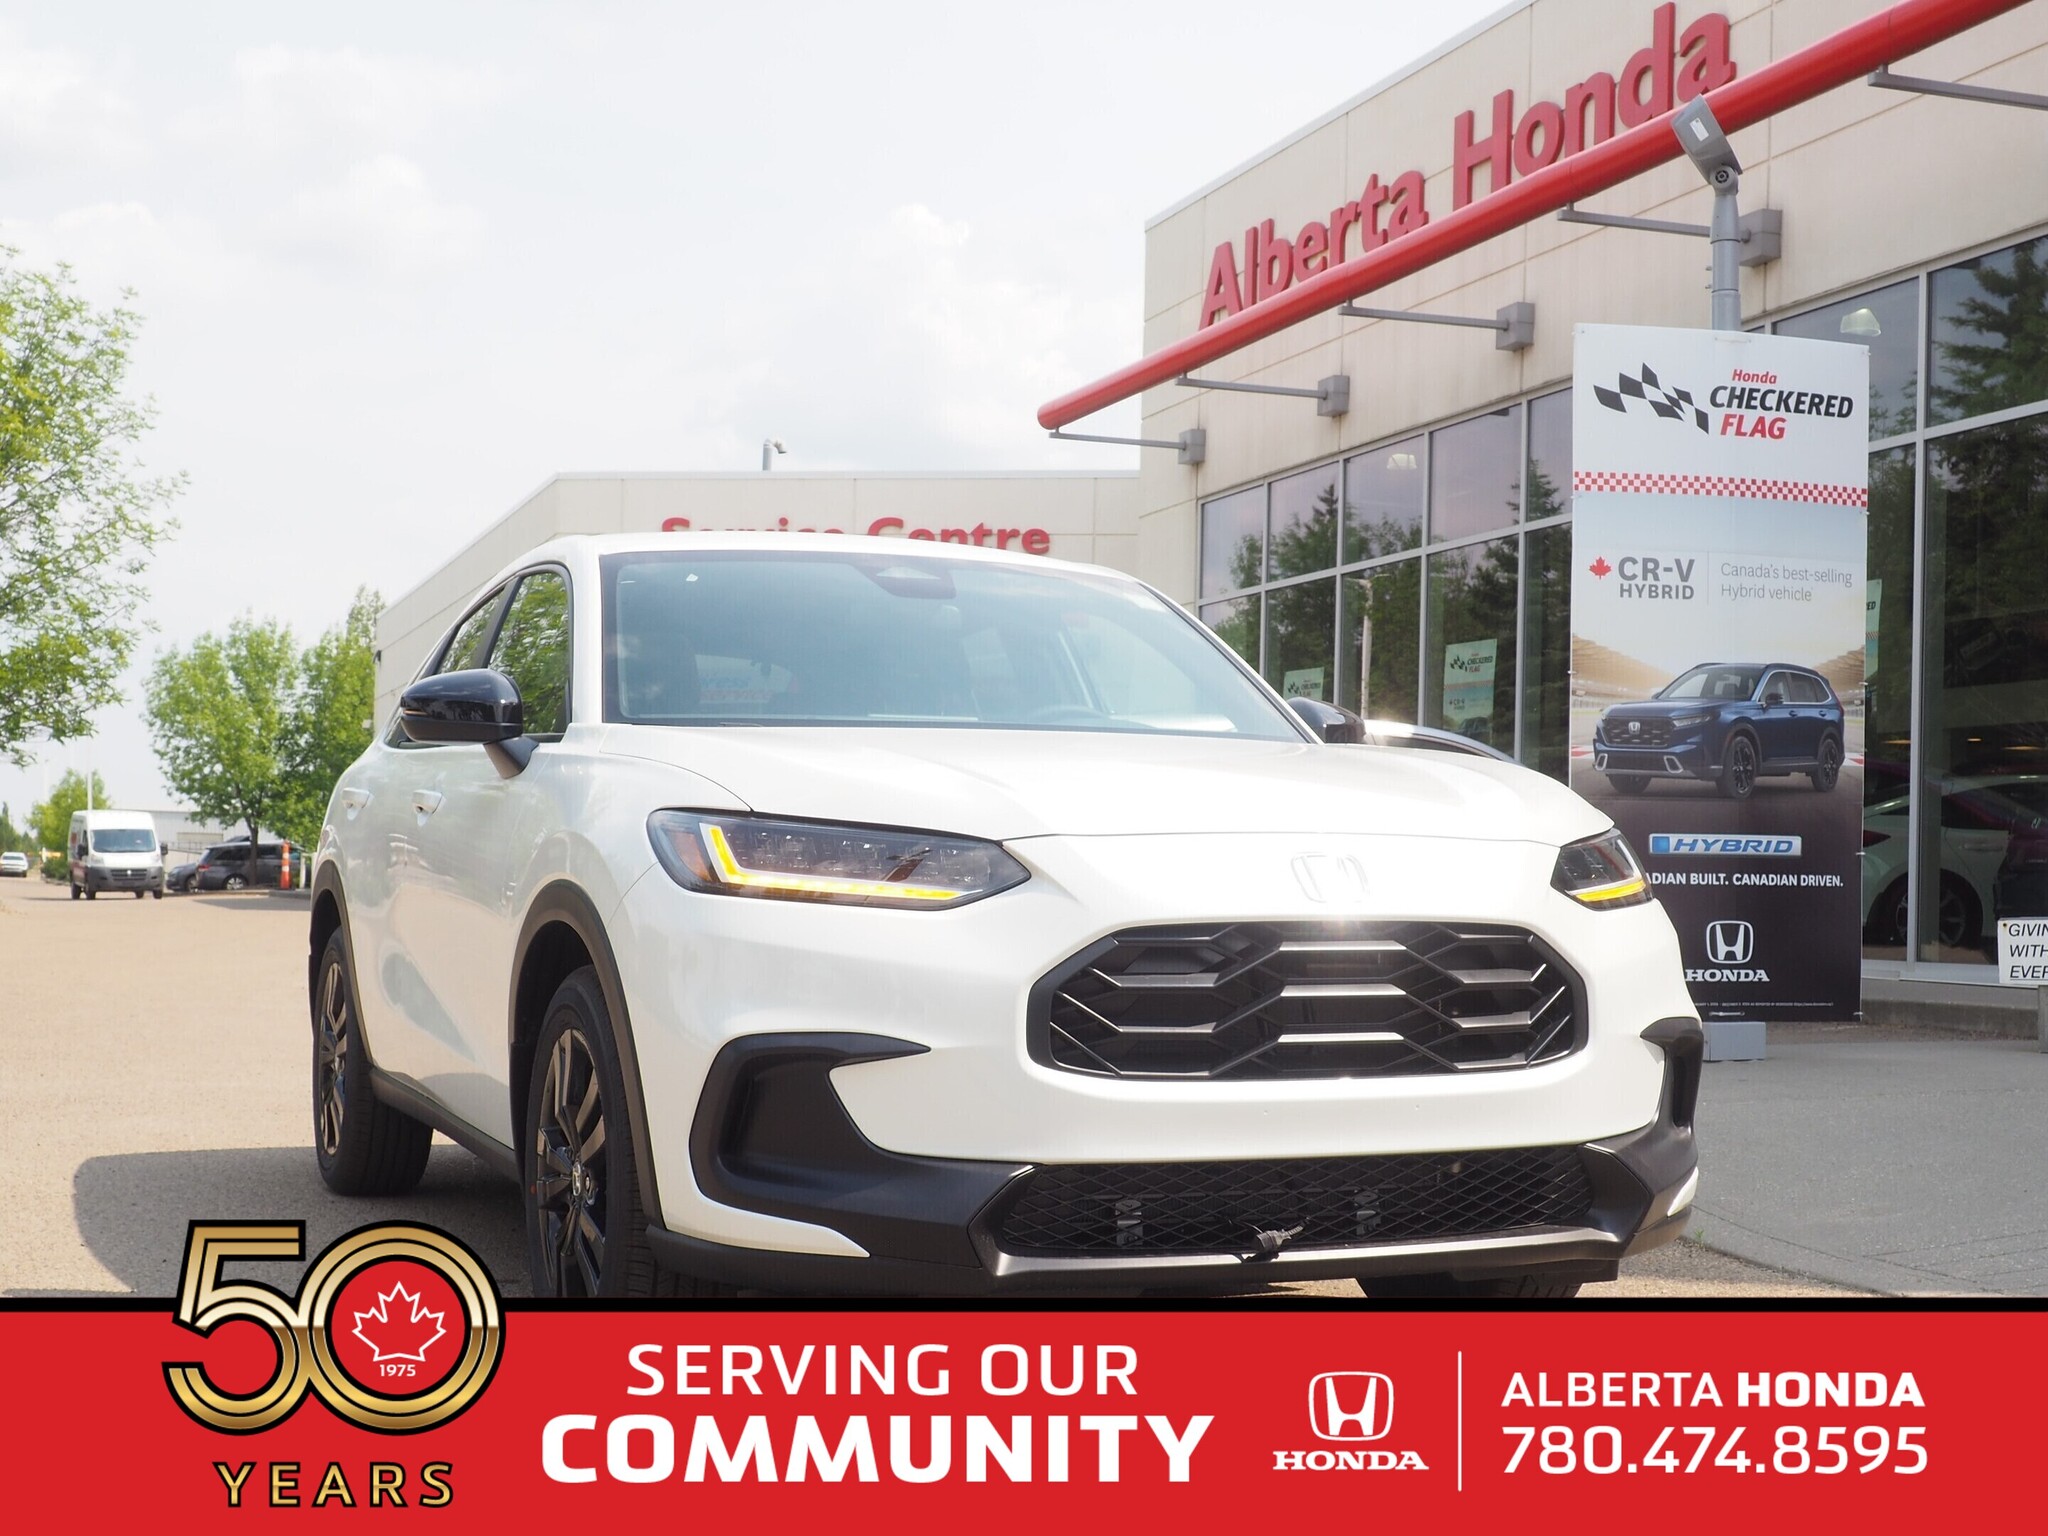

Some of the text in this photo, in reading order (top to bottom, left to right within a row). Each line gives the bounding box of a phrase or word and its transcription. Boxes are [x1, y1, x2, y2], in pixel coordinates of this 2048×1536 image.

[1199, 2, 1737, 331] Alberta Honda
[1732, 369, 1777, 384] Honda
[1709, 385, 1853, 418] CHECKERED
[1720, 413, 1787, 440] FLAG
[1618, 556, 1695, 583] CR-V
[1720, 562, 1853, 588] Canada's best-selling
[1619, 583, 1695, 600] HYBRID
[1720, 584, 1767, 601] Hybrid
[1673, 838, 1794, 853] HYBRID
[1690, 873, 1729, 886] BUILT.
[1732, 874, 1798, 887] CANADIAN
[1800, 874, 1844, 887] DRIVEN.
[2009, 944, 2048, 958] WITH
[1685, 968, 1771, 982] HONDA
